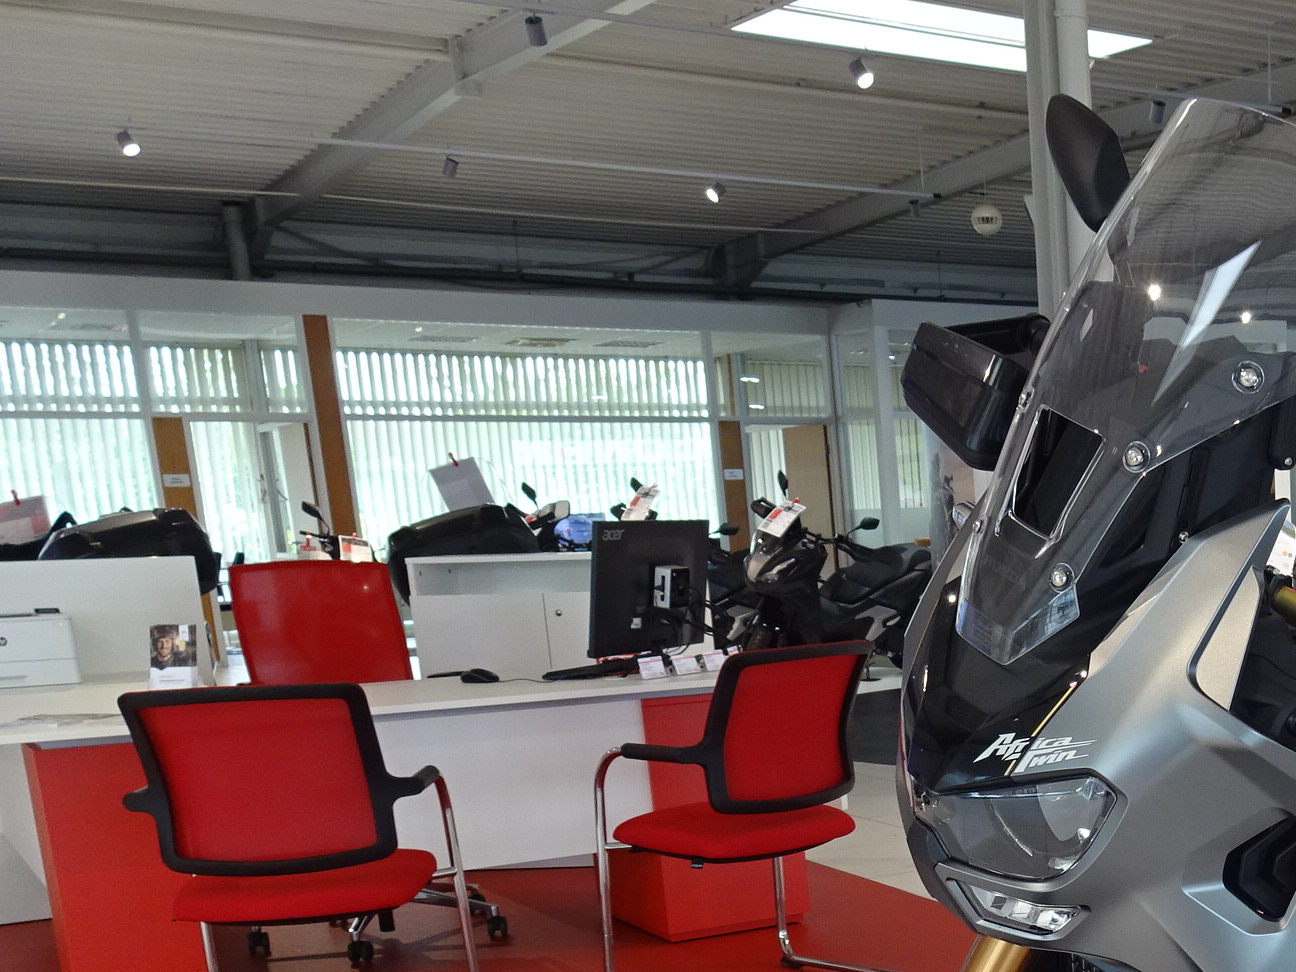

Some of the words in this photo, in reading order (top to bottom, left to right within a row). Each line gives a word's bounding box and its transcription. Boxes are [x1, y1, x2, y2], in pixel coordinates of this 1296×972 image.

[602, 529, 625, 541] acer
[972, 732, 1099, 763] Africa
[1013, 742, 1094, 774] Twin
